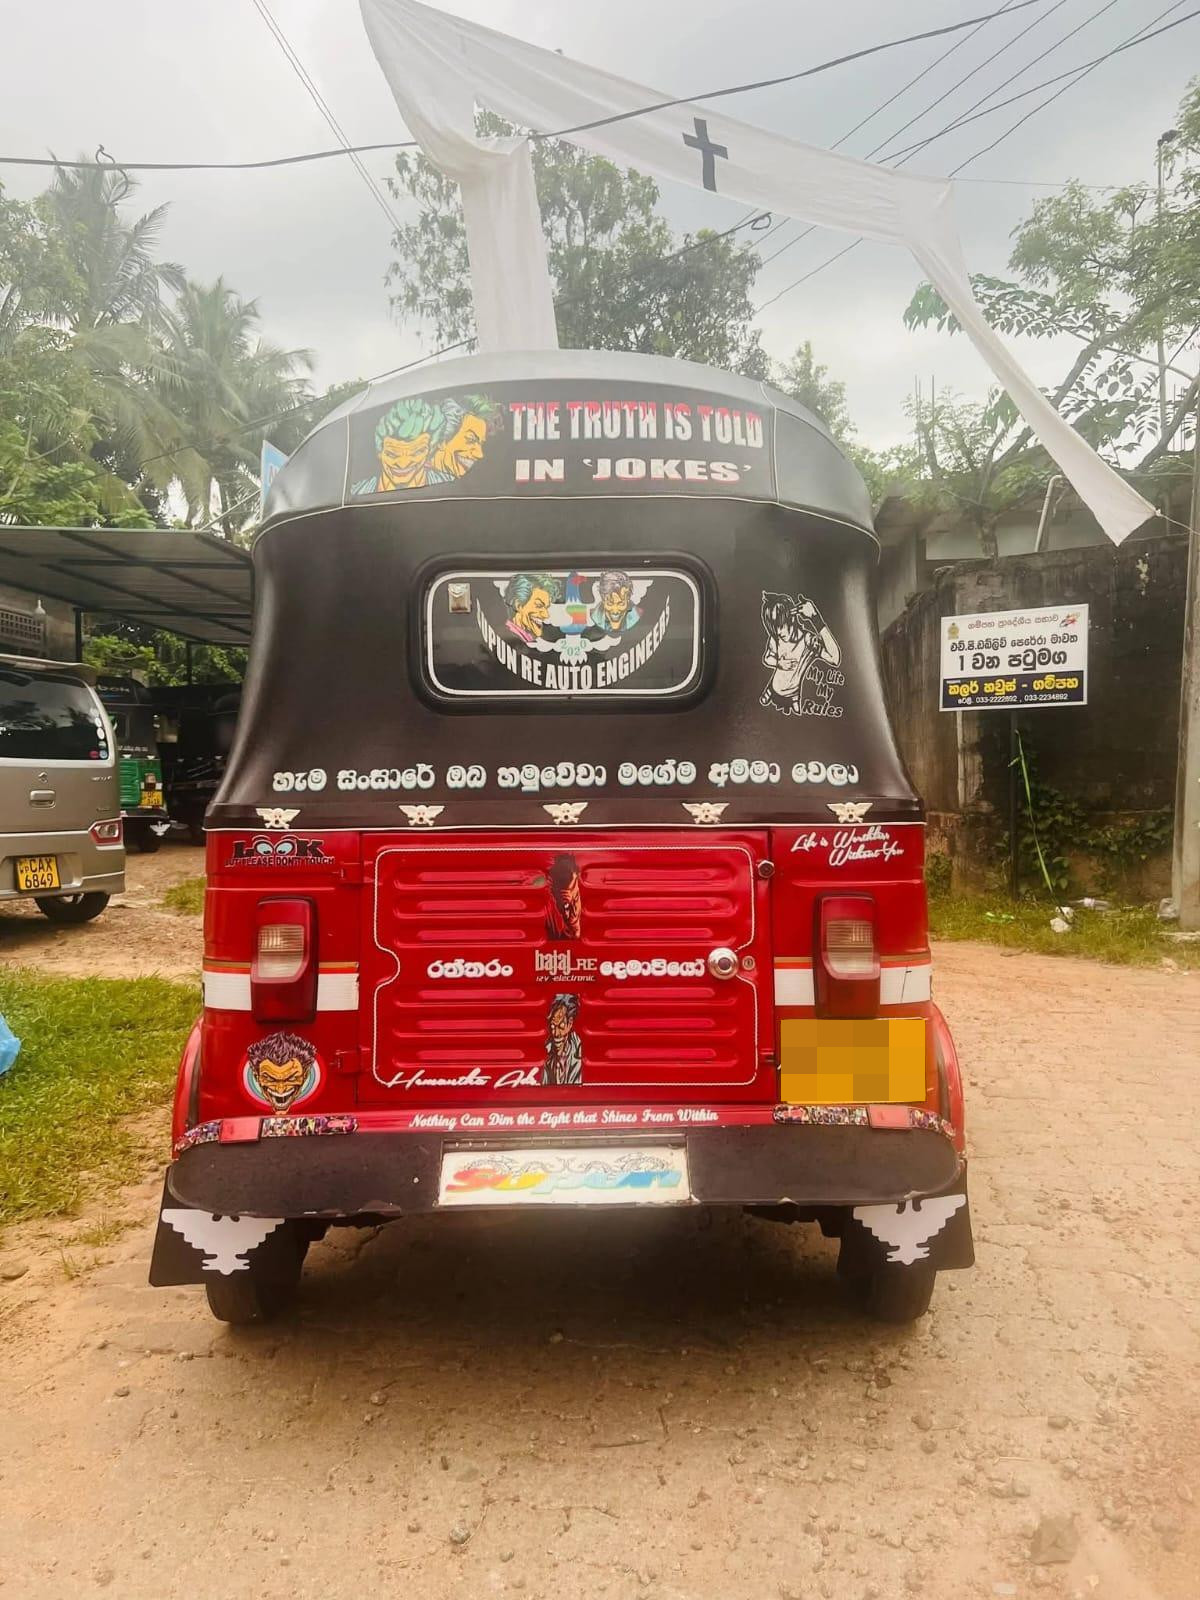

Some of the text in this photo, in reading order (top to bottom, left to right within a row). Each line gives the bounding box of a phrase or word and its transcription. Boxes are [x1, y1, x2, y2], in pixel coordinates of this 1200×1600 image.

[509, 400, 764, 449] THE TRUTH IS TOLD
[515, 458, 565, 483] IN
[521, 655, 542, 687] RE
[545, 664, 593, 691] AUTO
[597, 595, 670, 689] ENGINEERS
[959, 648, 1067, 671] 1 වන පටුමග
[1032, 674, 1079, 690] ගම්පහ
[802, 700, 843, 717] Rules
[272, 768, 328, 792] හැම
[336, 762, 436, 791] සංසාරේ
[446, 764, 488, 790] ඔබ
[617, 759, 697, 786] මගේම
[708, 758, 781, 788] අම්මා
[791, 760, 860, 787] වෙලා
[29, 858, 53, 873] CAX
[25, 873, 53, 888] 6849
[426, 958, 514, 979] රත්තරං
[535, 949, 598, 975] bajaj RE
[408, 1107, 719, 1131] Nothing Can Dim the Light that Shines From Within
